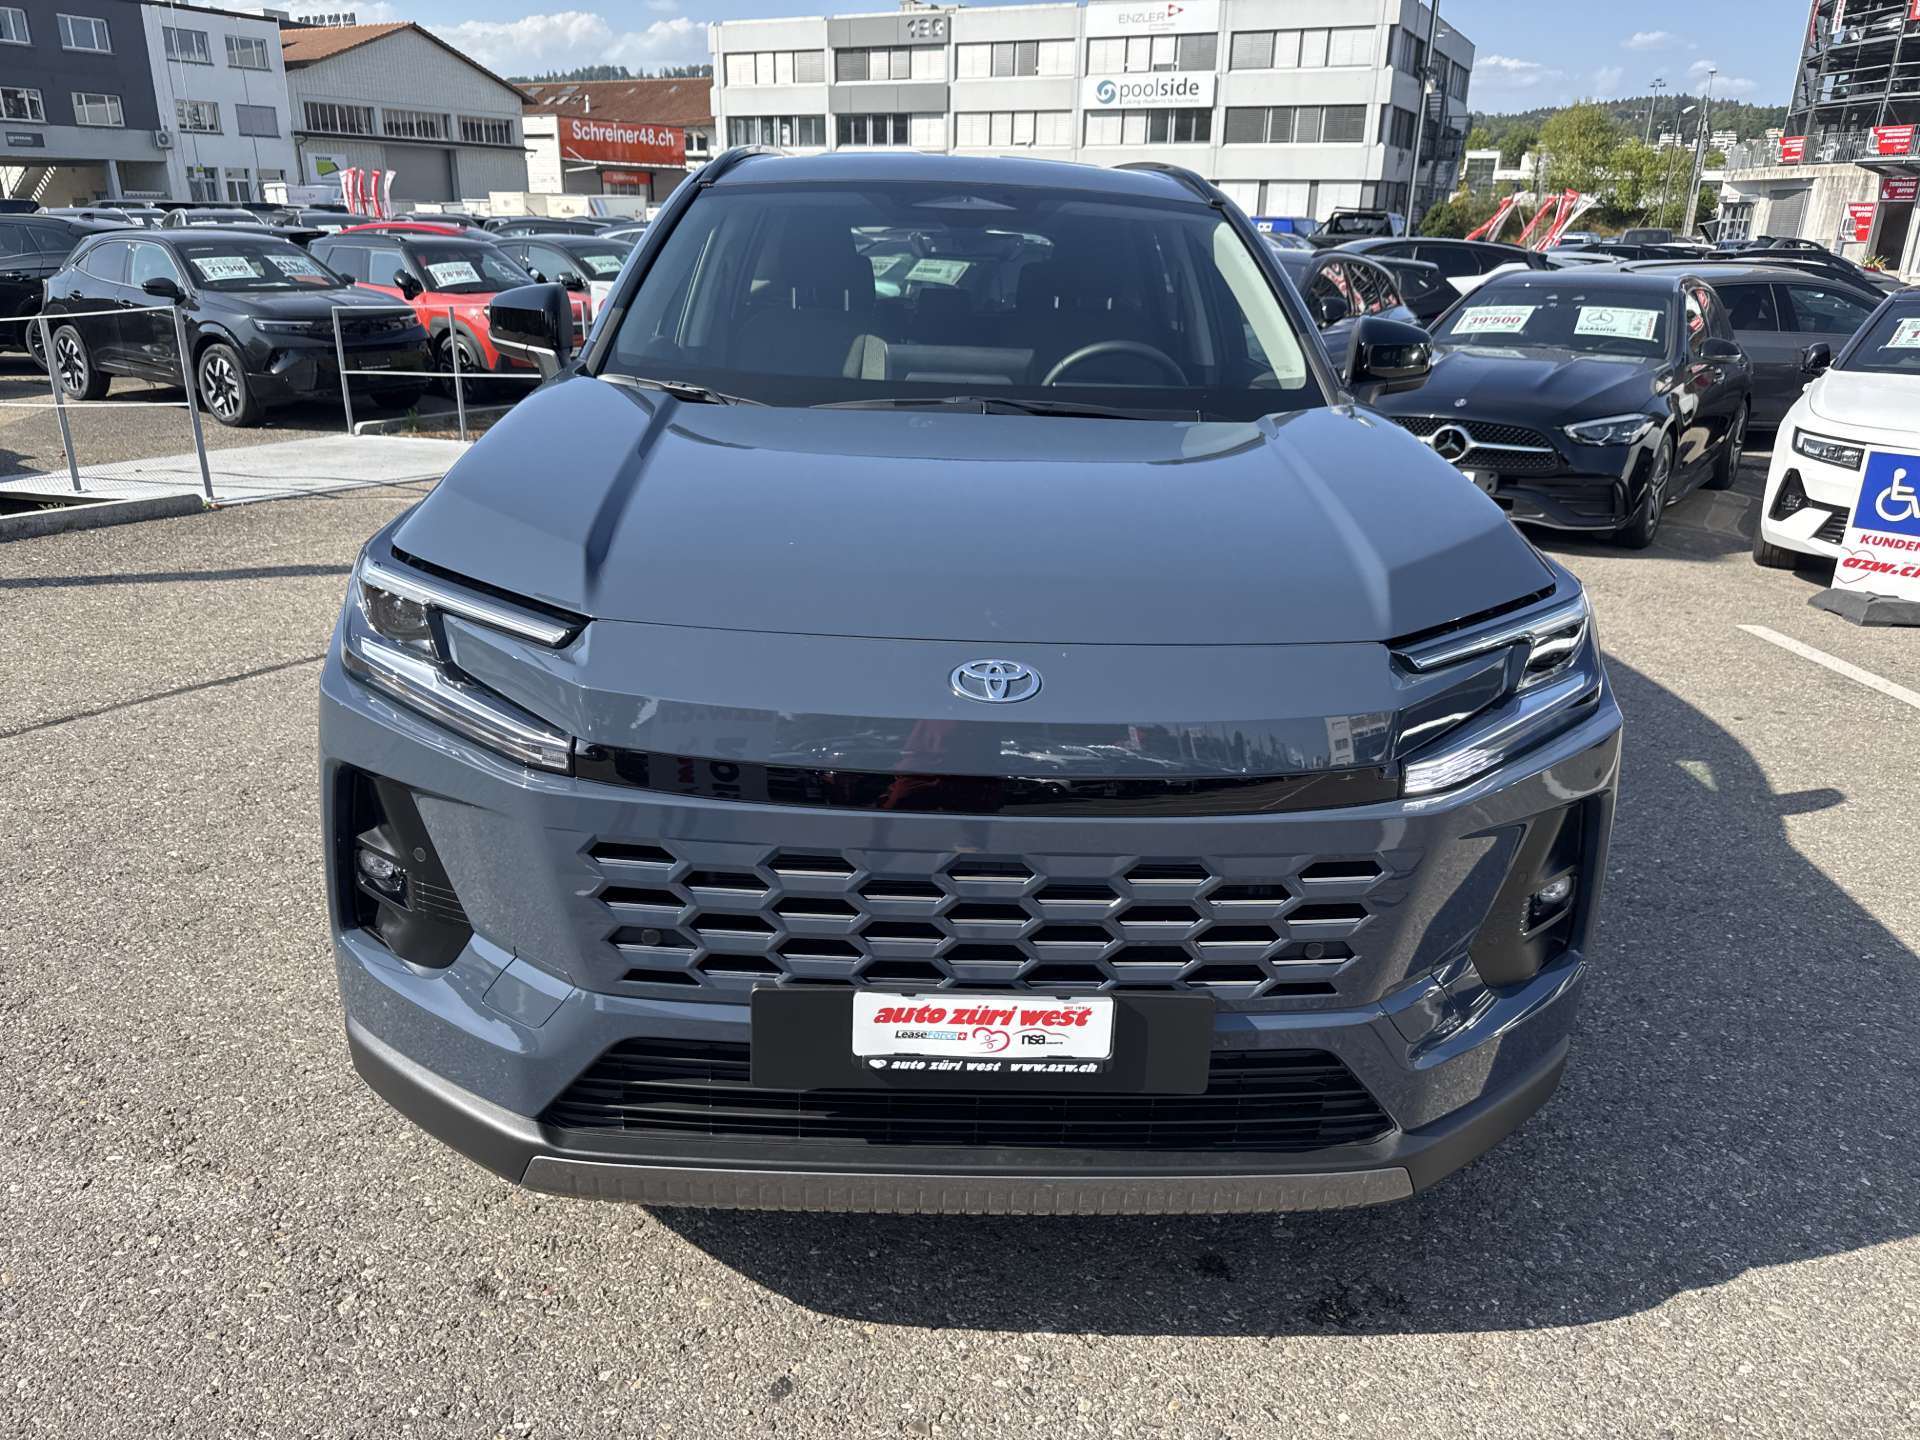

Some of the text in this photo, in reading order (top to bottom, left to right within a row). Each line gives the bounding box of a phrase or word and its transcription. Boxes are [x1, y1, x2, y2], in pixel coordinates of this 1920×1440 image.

[1118, 12, 1166, 24] ENZLER
[1119, 77, 1200, 105] poolside
[572, 119, 675, 147] Schreiner48.ch
[873, 1003, 1093, 1027] auto züri west
[1021, 1034, 1046, 1045] nsa
[891, 1060, 1098, 1073] auto züri west www.azw.ch
